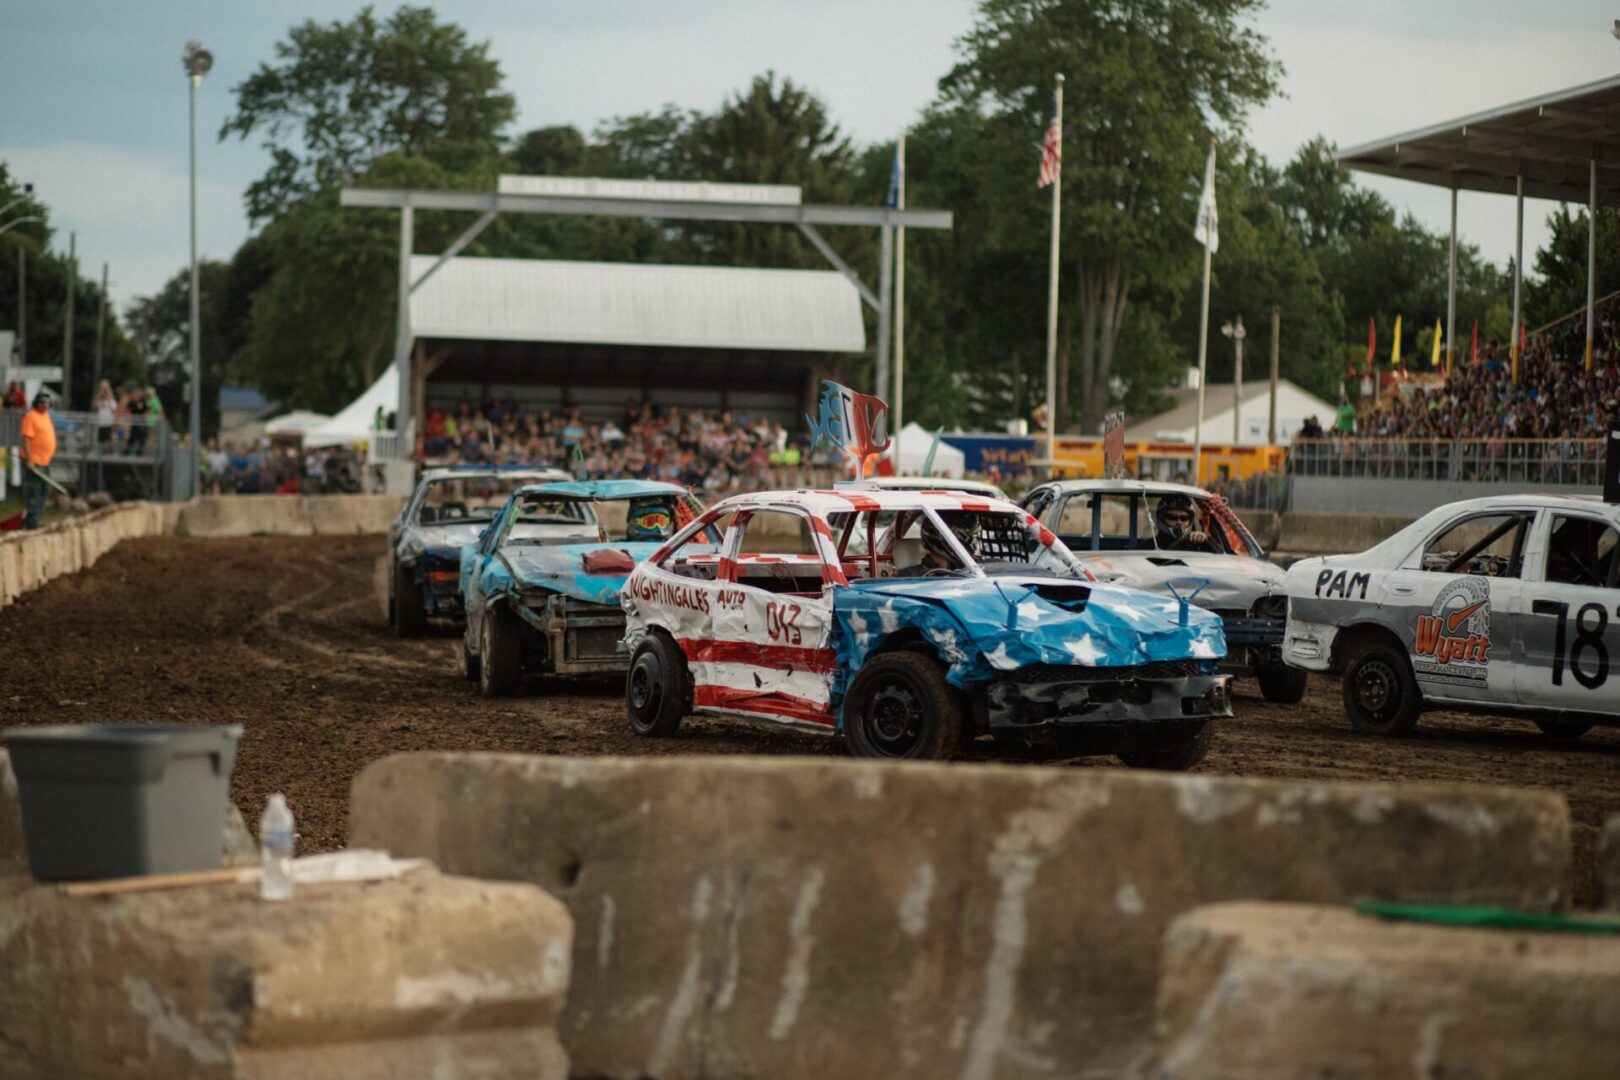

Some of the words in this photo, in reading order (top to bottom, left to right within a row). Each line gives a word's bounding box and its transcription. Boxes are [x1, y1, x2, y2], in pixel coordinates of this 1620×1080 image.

[630, 575, 710, 615] NIGHTINGALE'S
[717, 589, 746, 605] AUTO
[1315, 568, 1371, 600] PAM
[766, 601, 802, 646] 013
[1415, 614, 1492, 665] Wyatt
[1532, 599, 1620, 690] 78
